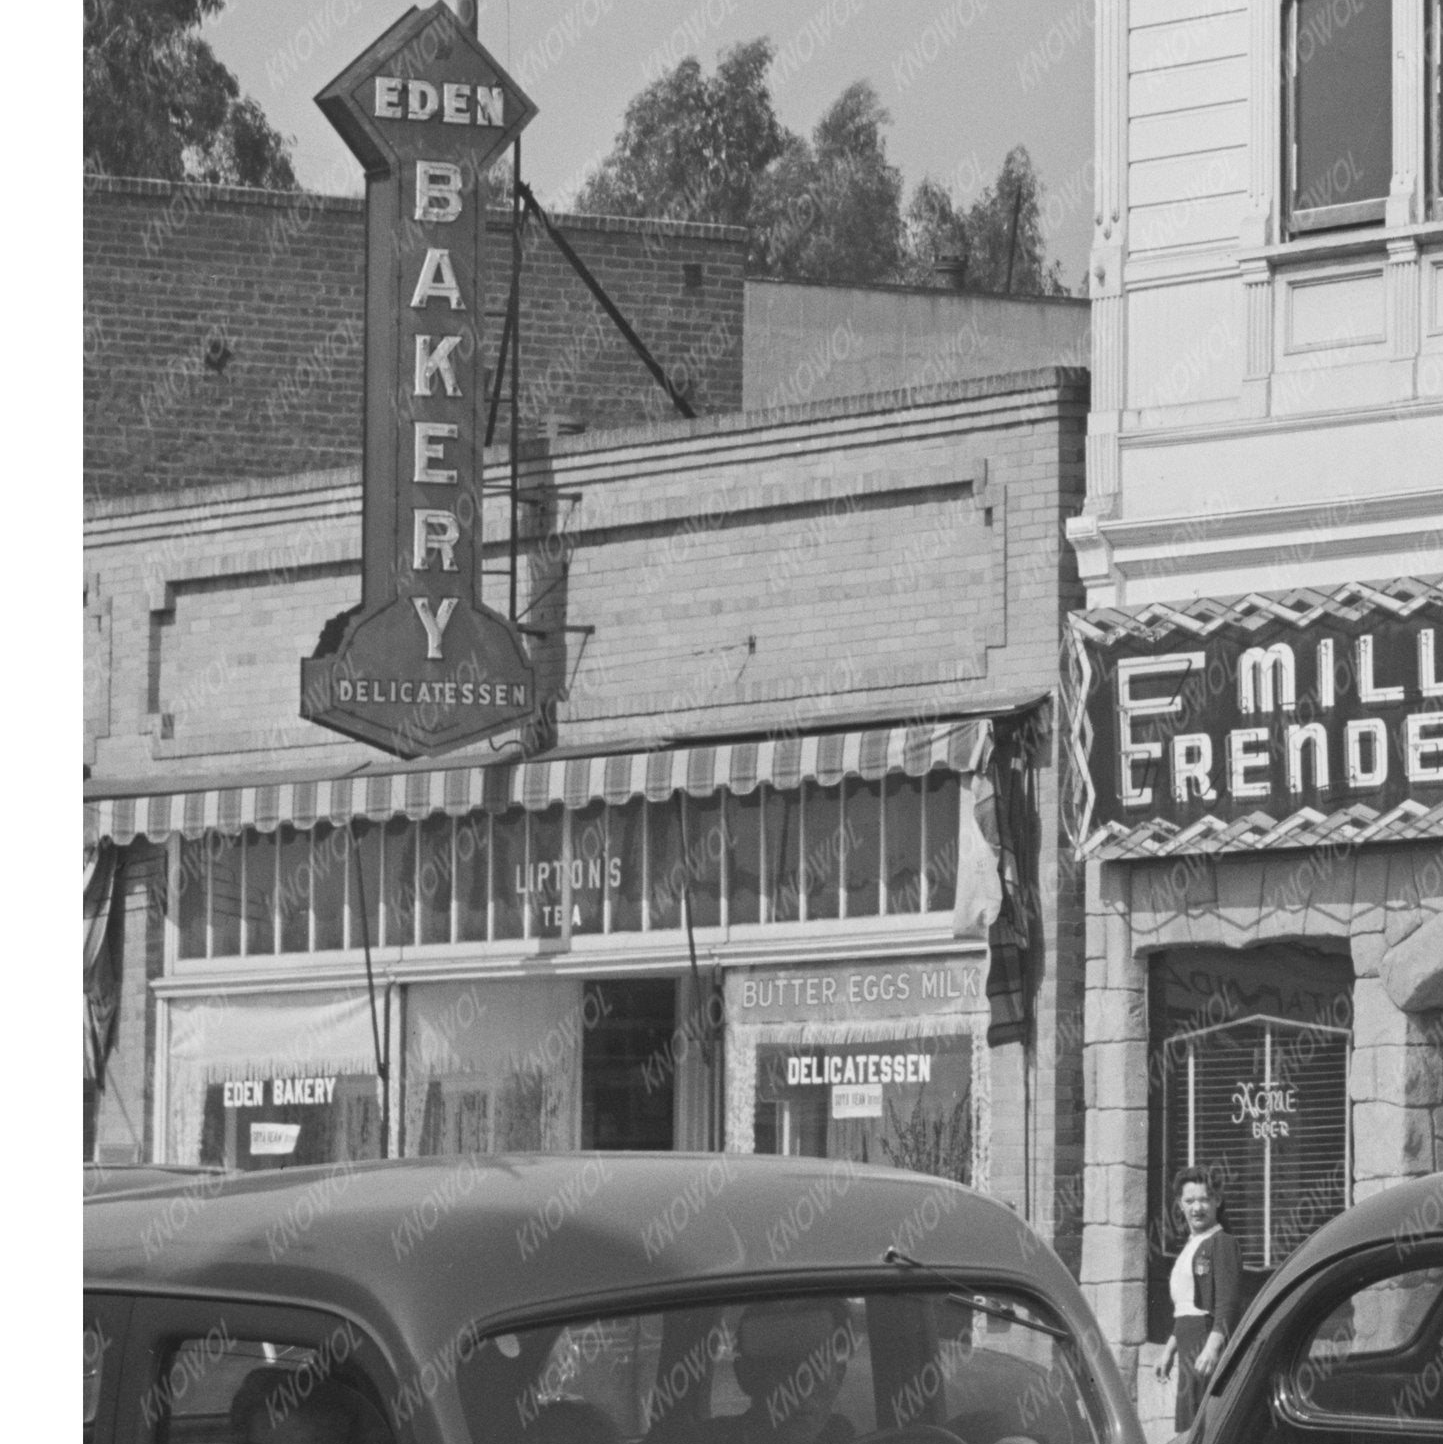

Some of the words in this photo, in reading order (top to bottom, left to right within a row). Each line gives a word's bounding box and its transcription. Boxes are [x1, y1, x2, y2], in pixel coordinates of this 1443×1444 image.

[374, 76, 505, 127] EDEN
[410, 160, 467, 659] BAKERY
[339, 680, 525, 706] DELICATESSEN
[543, 904, 582, 927] TEA
[743, 977, 837, 1008] BUTTER
[850, 973, 910, 1003] EGGS
[922, 968, 978, 999] MILK
[787, 1054, 931, 1085] DELICATESSEN
[223, 1080, 264, 1107] EDEN
[273, 1077, 337, 1105] BAKERY
